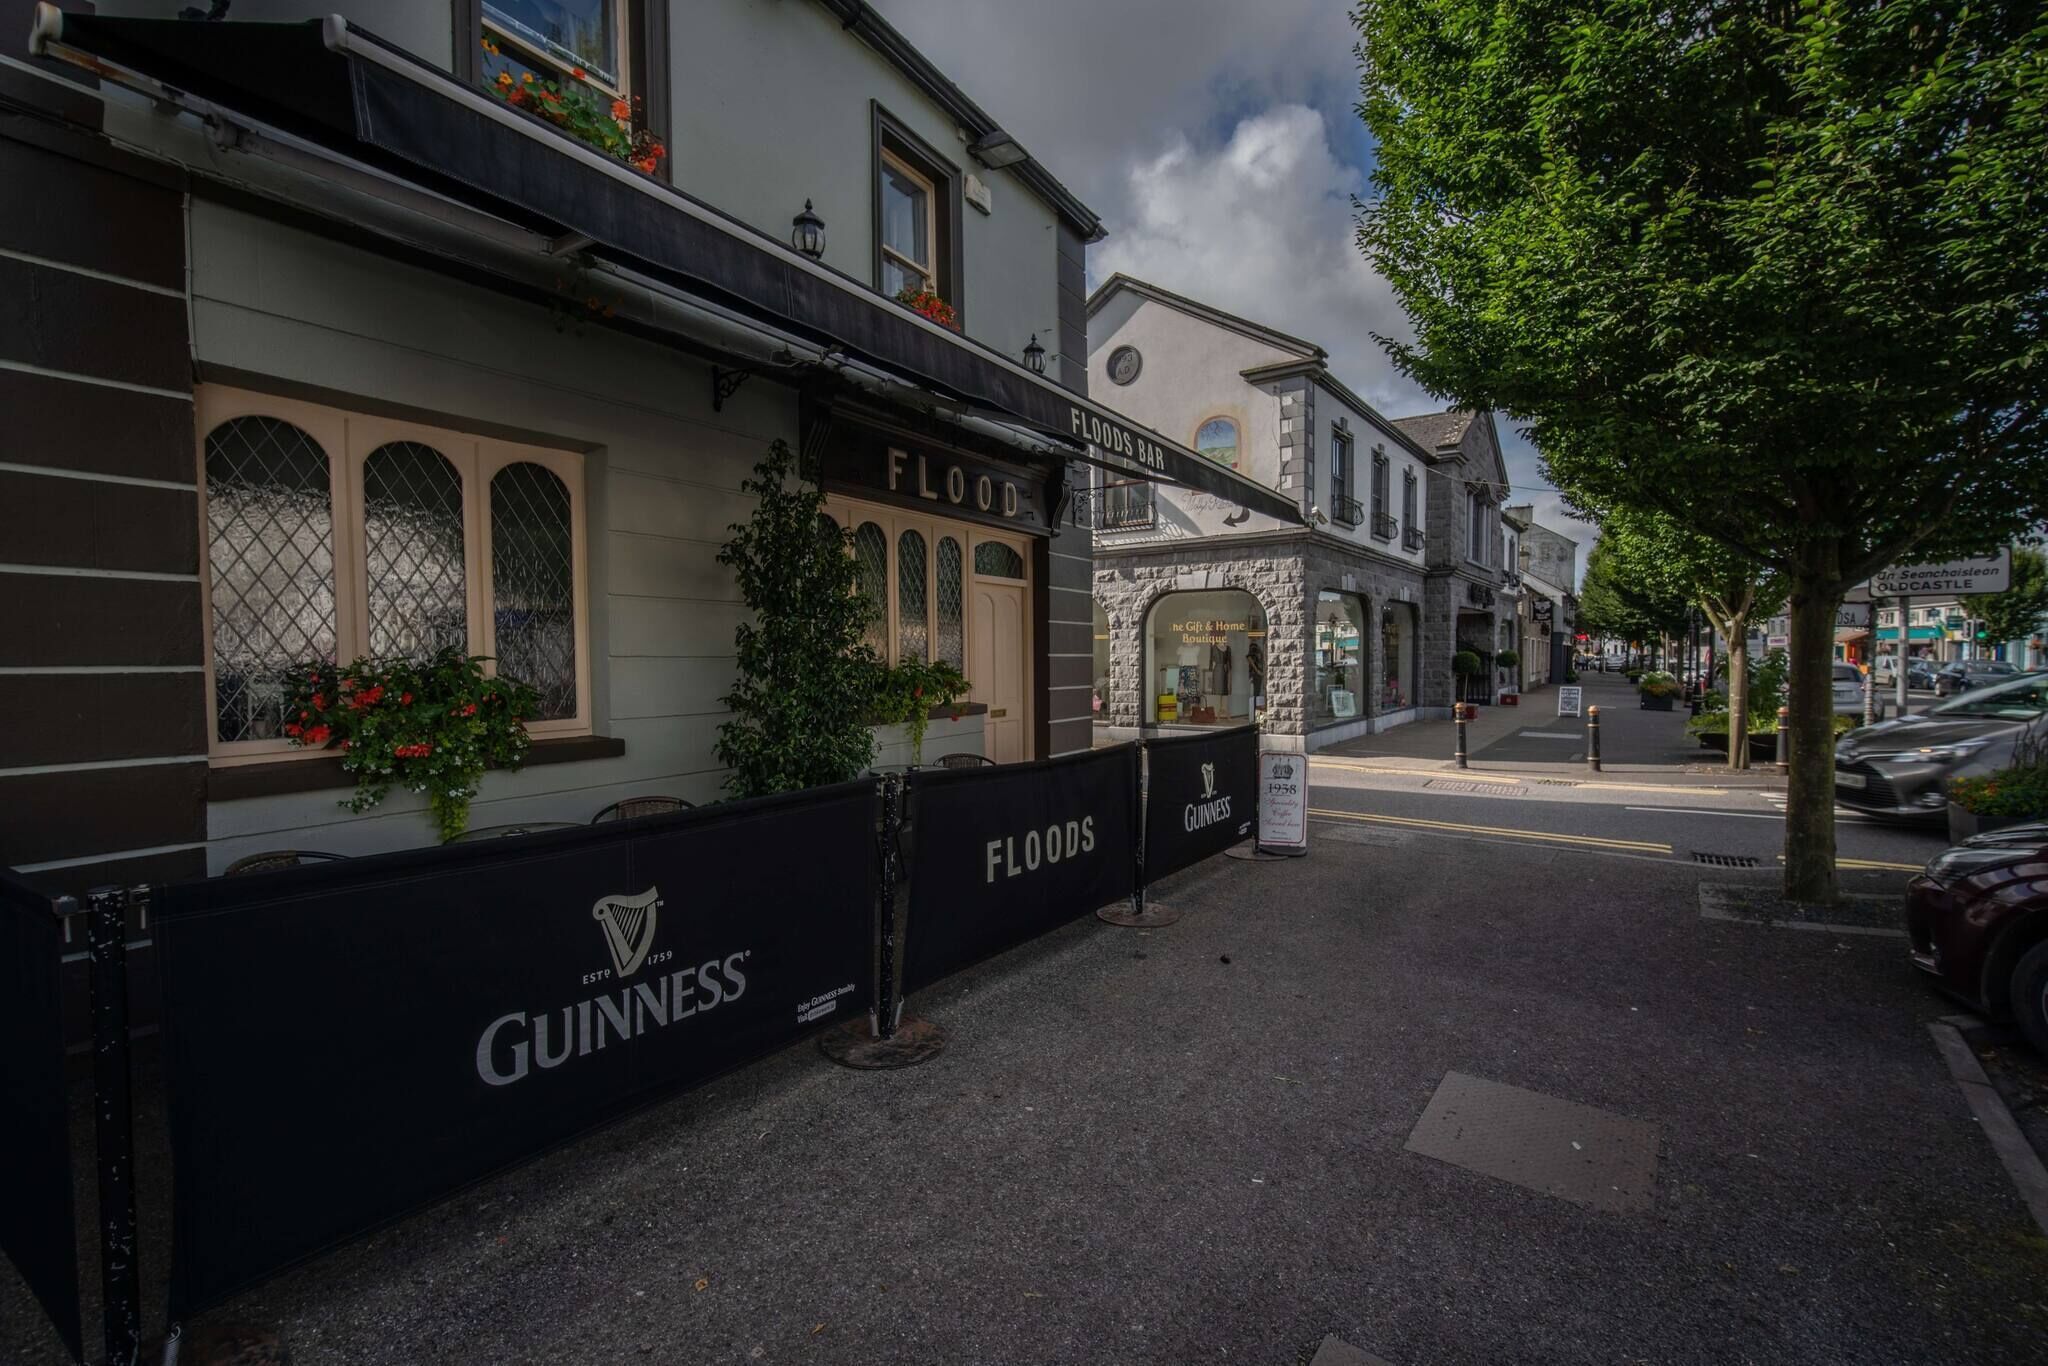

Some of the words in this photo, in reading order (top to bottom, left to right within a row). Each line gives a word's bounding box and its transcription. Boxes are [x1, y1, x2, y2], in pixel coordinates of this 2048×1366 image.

[1071, 408, 1133, 456] FLOODS
[1138, 438, 1165, 470] BAR
[888, 446, 1017, 518] FLOOD
[1877, 579, 1974, 592] OLDCASTLE
[1182, 633, 1228, 646] Boutique
[1185, 621, 1203, 633] Gift
[1205, 620, 1213, 632] &
[1216, 621, 1245, 631] Home
[1185, 796, 1231, 832] GUINNESS
[987, 816, 1094, 883] FLOODS
[648, 950, 673, 965] 1759
[476, 951, 747, 1087] GUINNESS
